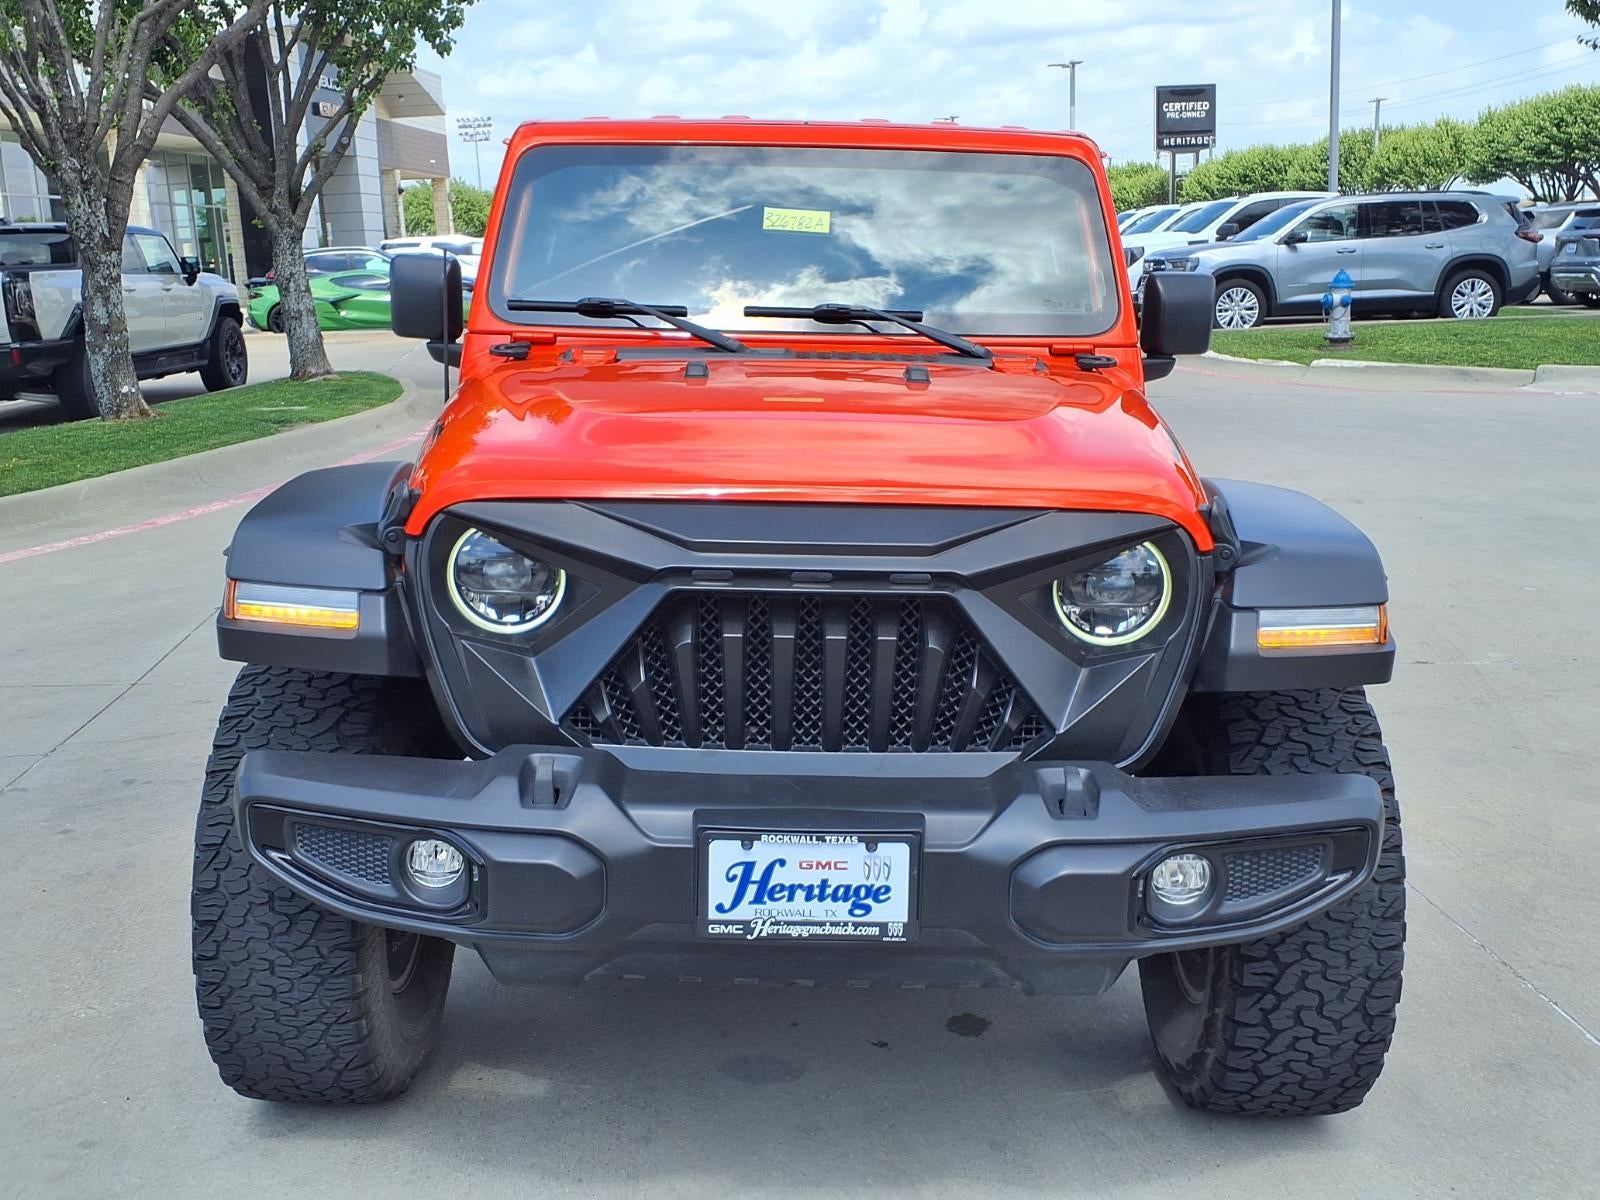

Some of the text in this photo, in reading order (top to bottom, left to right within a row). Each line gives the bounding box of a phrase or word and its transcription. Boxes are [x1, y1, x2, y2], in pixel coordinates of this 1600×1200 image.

[1162, 101, 1210, 112] CERTIFIED
[1166, 110, 1206, 119] PRE-OWNED
[1163, 136, 1209, 146] HERITAGE
[761, 834, 858, 845] ROCKWALL, TEXAS
[799, 860, 848, 871] GMC
[715, 858, 892, 918] Heritage
[824, 909, 837, 918] TX
[708, 924, 744, 934] GMC
[746, 917, 879, 940] Heritagegmcbuick.com
